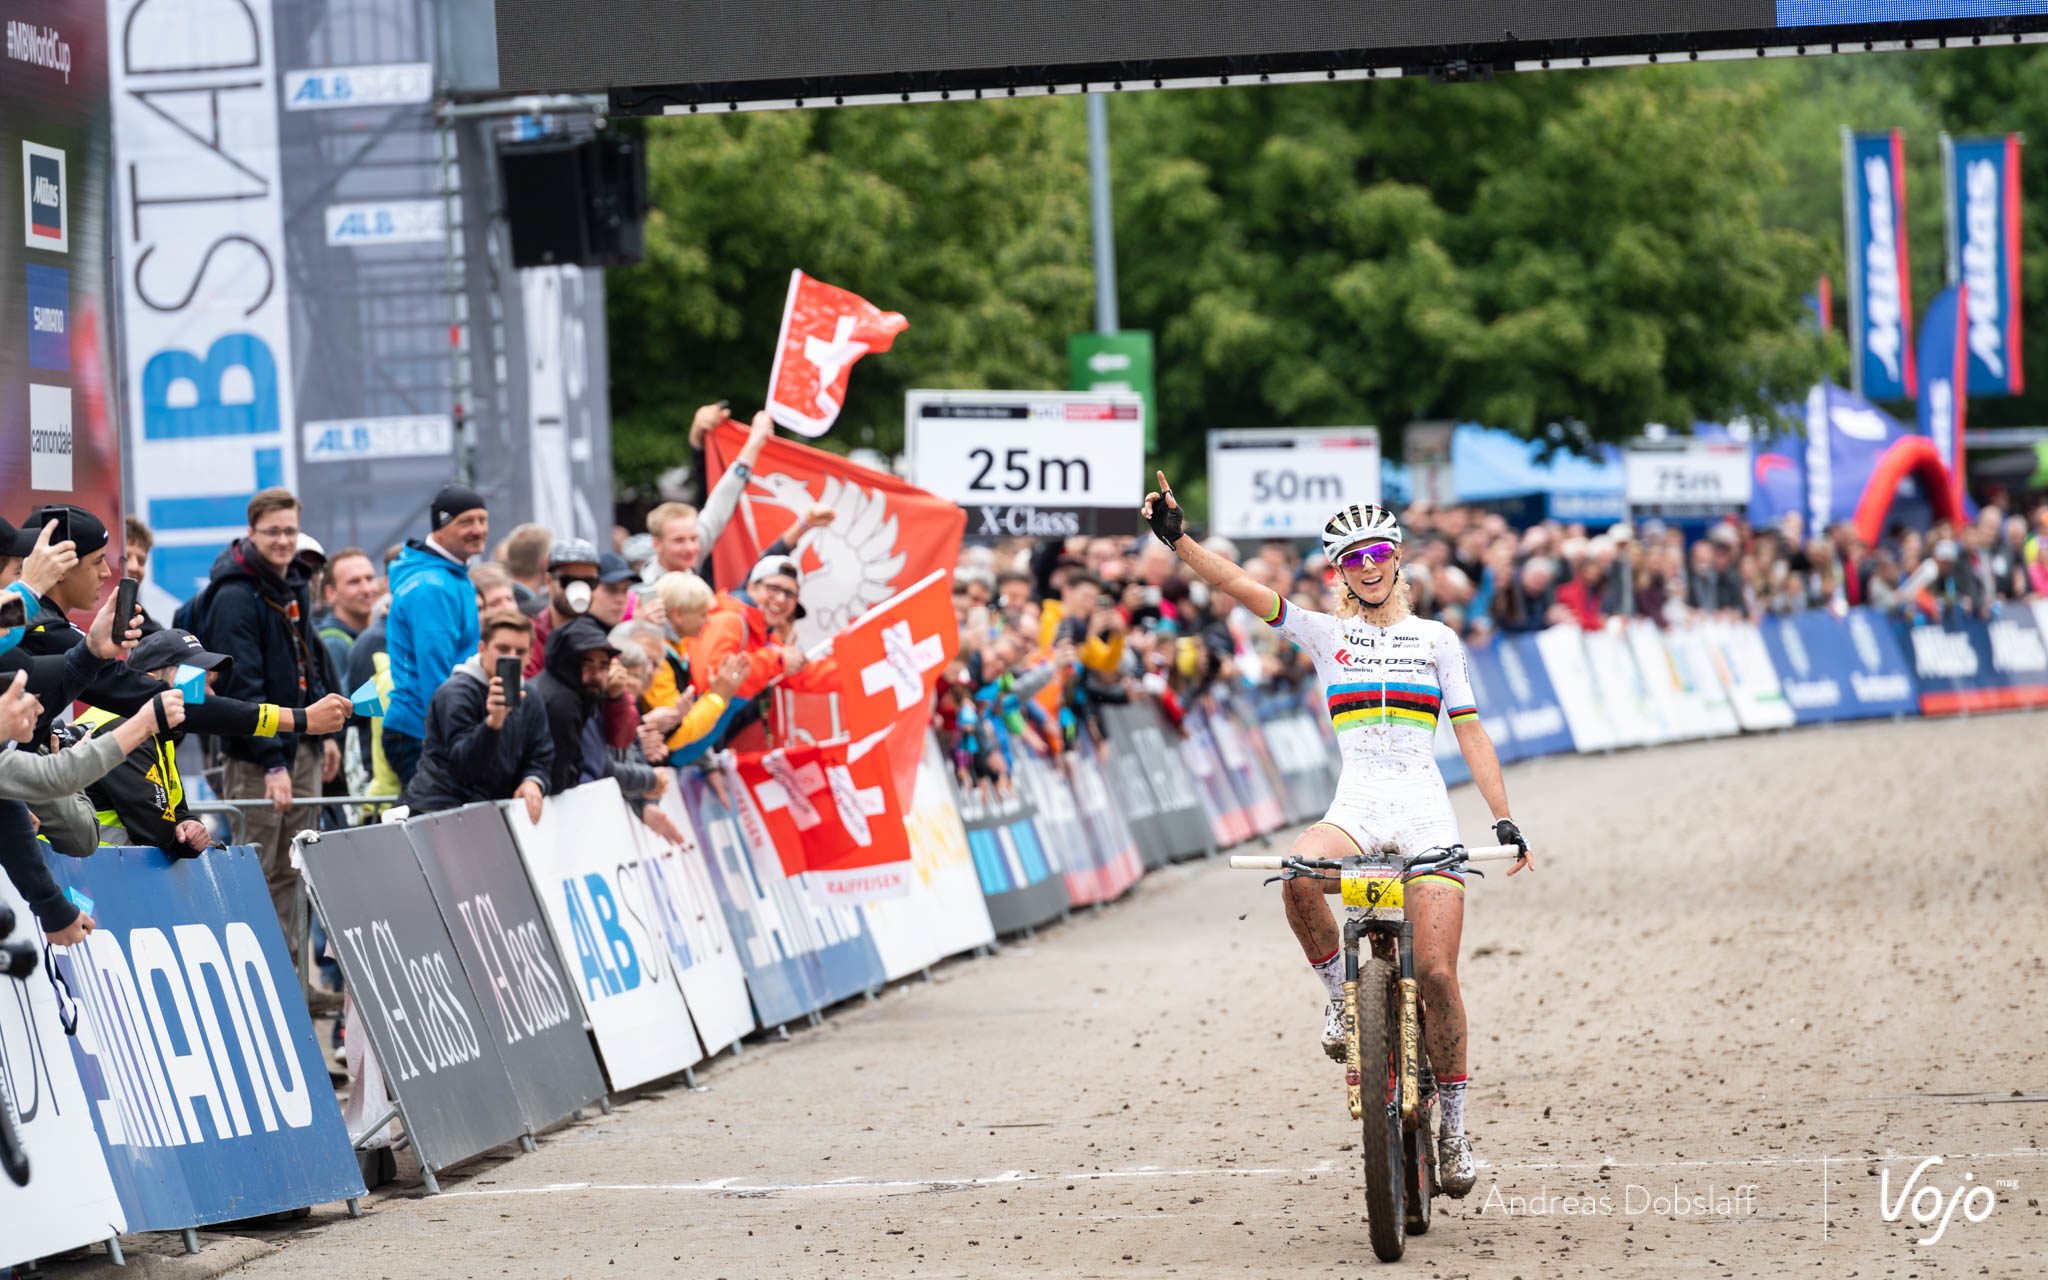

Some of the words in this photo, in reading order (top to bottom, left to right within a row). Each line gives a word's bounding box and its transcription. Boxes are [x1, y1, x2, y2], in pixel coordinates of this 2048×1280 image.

[7, 19, 71, 85] #MBWorldCup
[33, 306, 65, 334] SHIMANO
[31, 423, 72, 455] cannondale
[968, 448, 1090, 492] 25m
[1253, 469, 1344, 502] 50m
[978, 504, 1080, 537] X-Class
[1350, 635, 1375, 648] UCI
[1353, 656, 1427, 666] KROSS
[826, 873, 902, 895] RAIFFEISEN
[1366, 881, 1380, 904] 6
[457, 892, 571, 1045] X-Class
[343, 919, 481, 1081] X-Class
